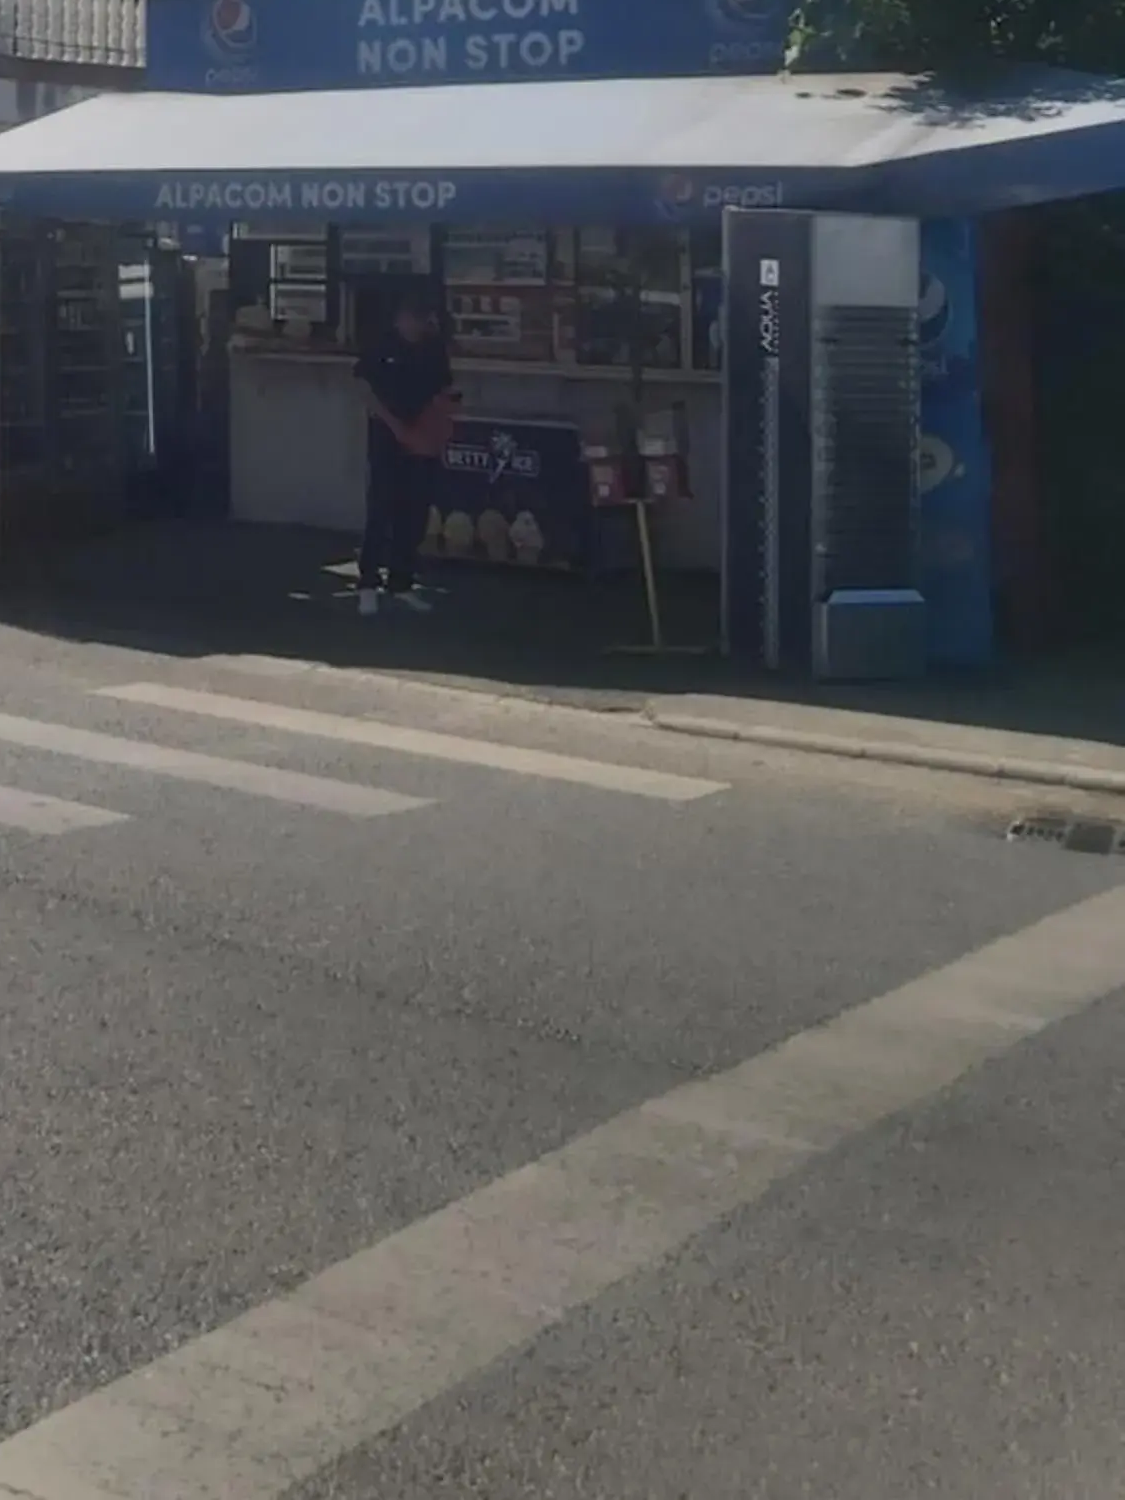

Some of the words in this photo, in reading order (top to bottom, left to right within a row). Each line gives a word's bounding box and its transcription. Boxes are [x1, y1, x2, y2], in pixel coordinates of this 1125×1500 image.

[358, 35, 448, 73] NON
[465, 28, 585, 69] STOP
[154, 181, 293, 209] ALPACOM
[300, 181, 366, 209] NON
[374, 180, 457, 209] STOP
[703, 180, 784, 208] pepsi
